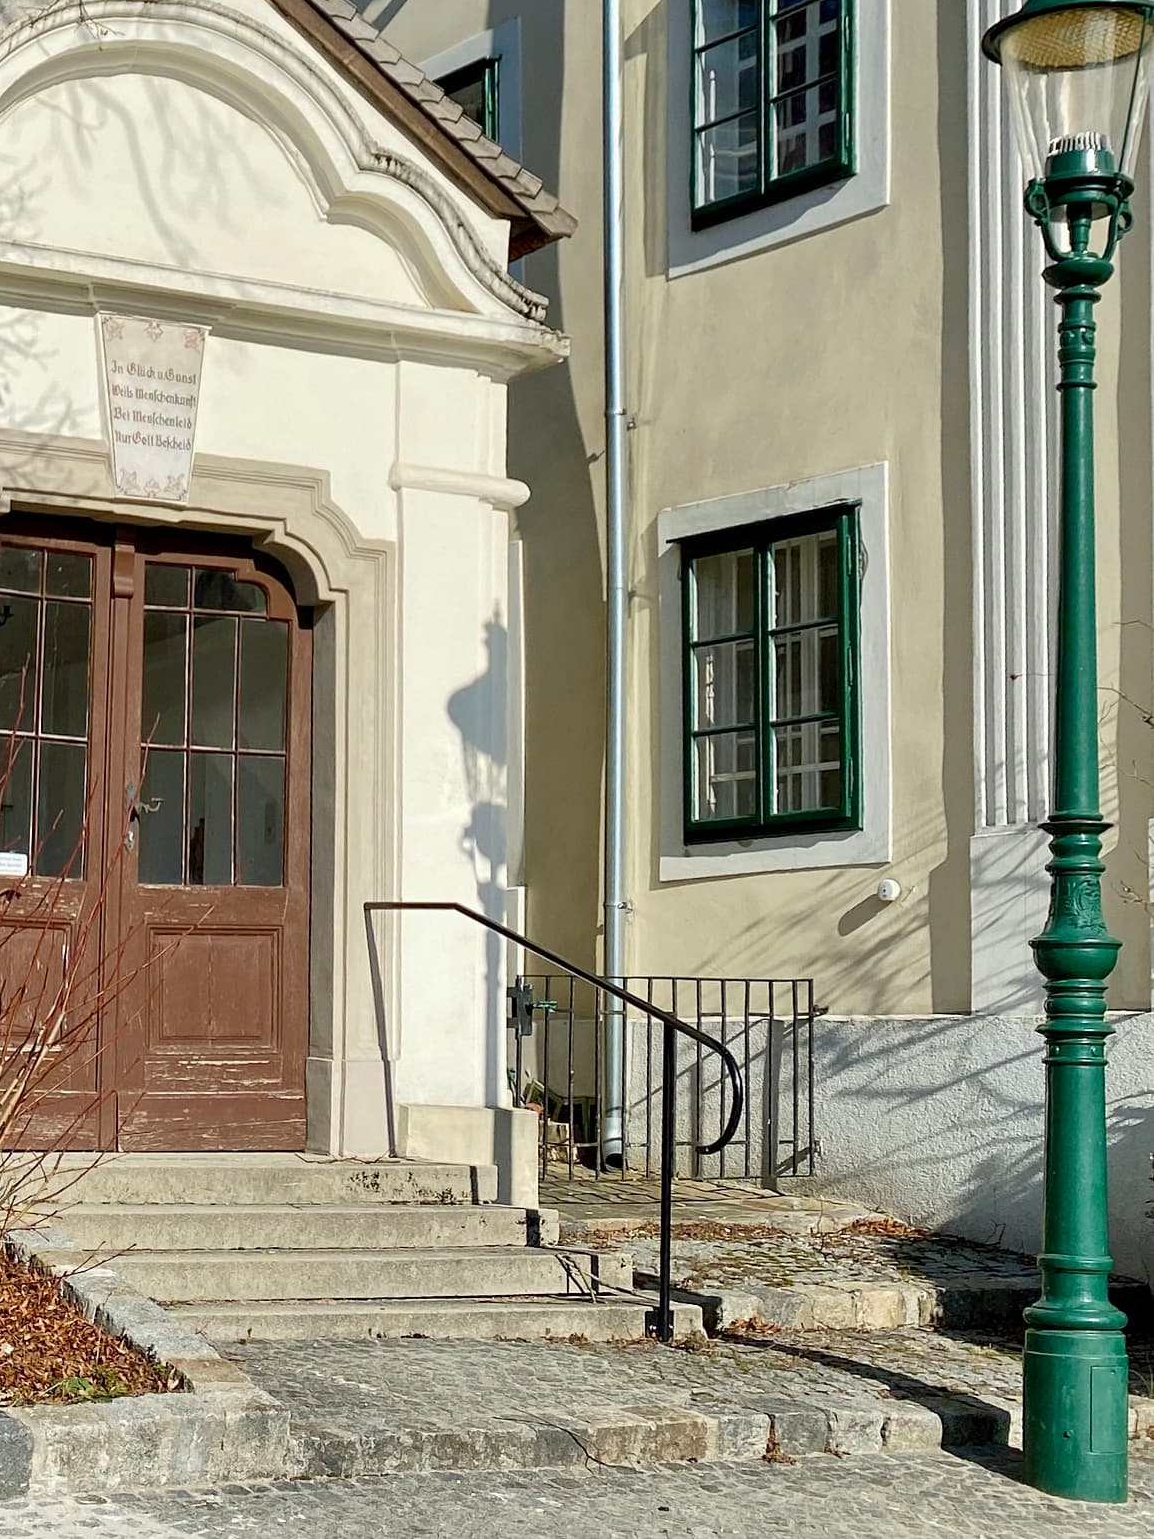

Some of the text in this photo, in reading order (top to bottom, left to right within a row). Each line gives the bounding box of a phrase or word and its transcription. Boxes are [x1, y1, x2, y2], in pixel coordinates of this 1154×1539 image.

[111, 360, 123, 374] In
[127, 362, 155, 379] Glück
[165, 367, 196, 385] Gunst
[114, 406, 130, 422] Bei
[132, 431, 153, 446] Gott
